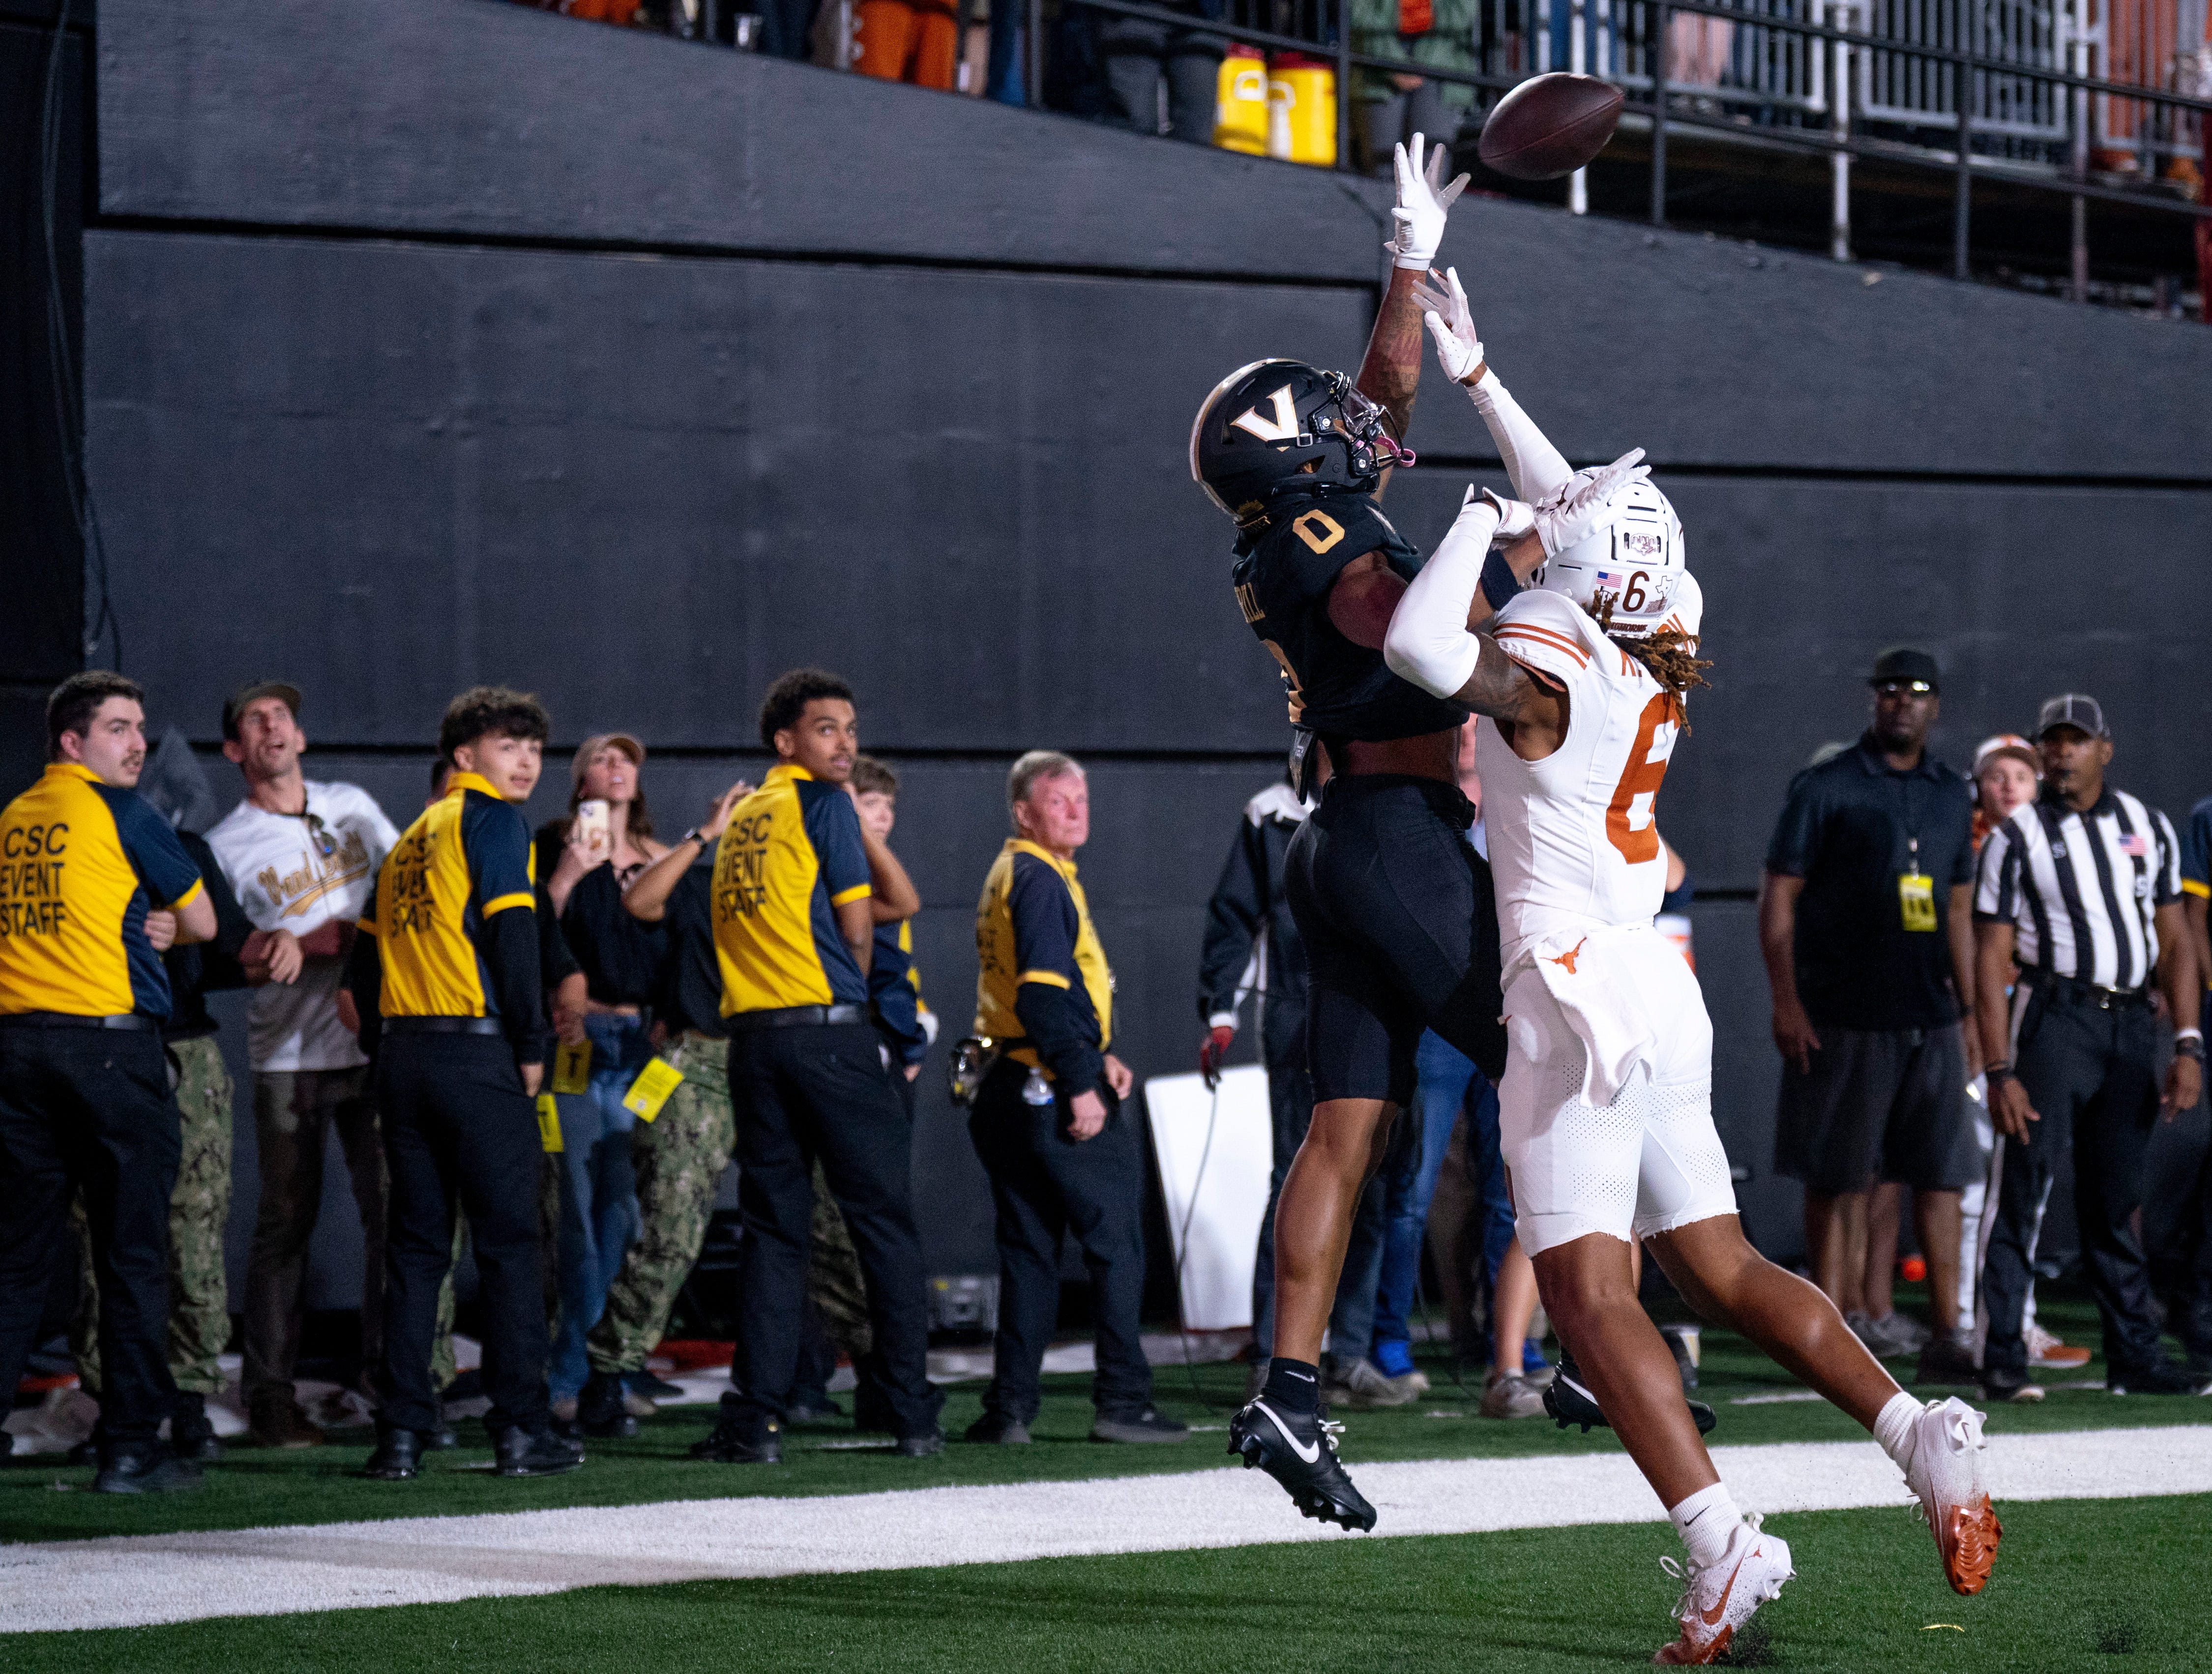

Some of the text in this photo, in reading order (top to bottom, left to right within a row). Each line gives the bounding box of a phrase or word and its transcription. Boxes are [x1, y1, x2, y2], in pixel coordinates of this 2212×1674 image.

[1230, 384, 1299, 452] V
[1293, 509, 1345, 554] 0
[1622, 570, 1650, 612] 6
[1606, 692, 1681, 865] 6
[4, 822, 69, 858] CSC
[0, 862, 65, 897] EVENT
[0, 900, 66, 937] STAFF
